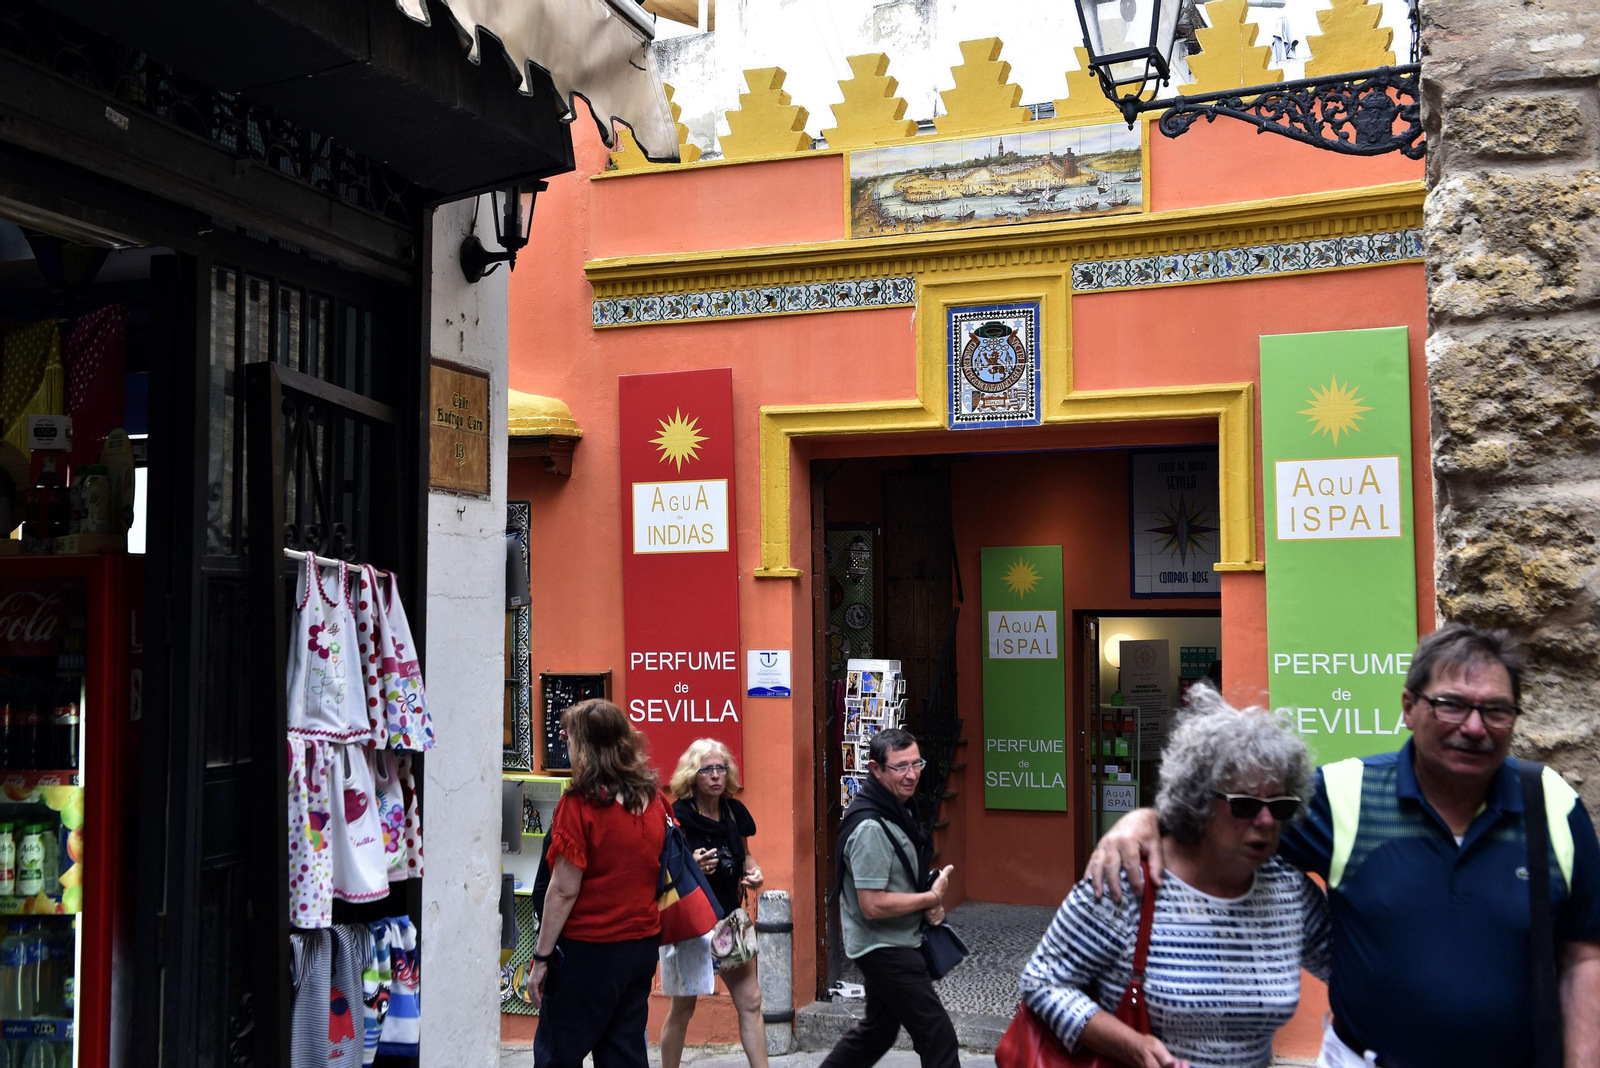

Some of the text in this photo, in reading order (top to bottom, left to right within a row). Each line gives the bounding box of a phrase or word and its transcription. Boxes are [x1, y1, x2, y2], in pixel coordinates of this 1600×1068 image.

[467, 416, 483, 432] Caro
[455, 442, 464, 459] 13
[1166, 474, 1197, 490] SEVILLA
[1292, 464, 1381, 498] AQUA
[651, 485, 709, 512] AGUA
[1290, 503, 1389, 533] ISPAL
[648, 523, 714, 546] INDIAS
[1159, 571, 1209, 584] COMPASS ROSE
[997, 614, 1047, 635] AQUA
[995, 637, 1052, 656] ISPAL
[631, 651, 736, 671] PERFUME
[1274, 653, 1413, 675] PERFUME
[674, 681, 689, 694] de
[1332, 687, 1352, 701] de
[629, 699, 739, 723] SEVILLA
[987, 738, 1064, 754] PERFUME
[1018, 759, 1029, 769] de
[986, 770, 1066, 789] SEVILLA
[1105, 789, 1132, 798] AQUA
[1107, 799, 1133, 807] SPAL
